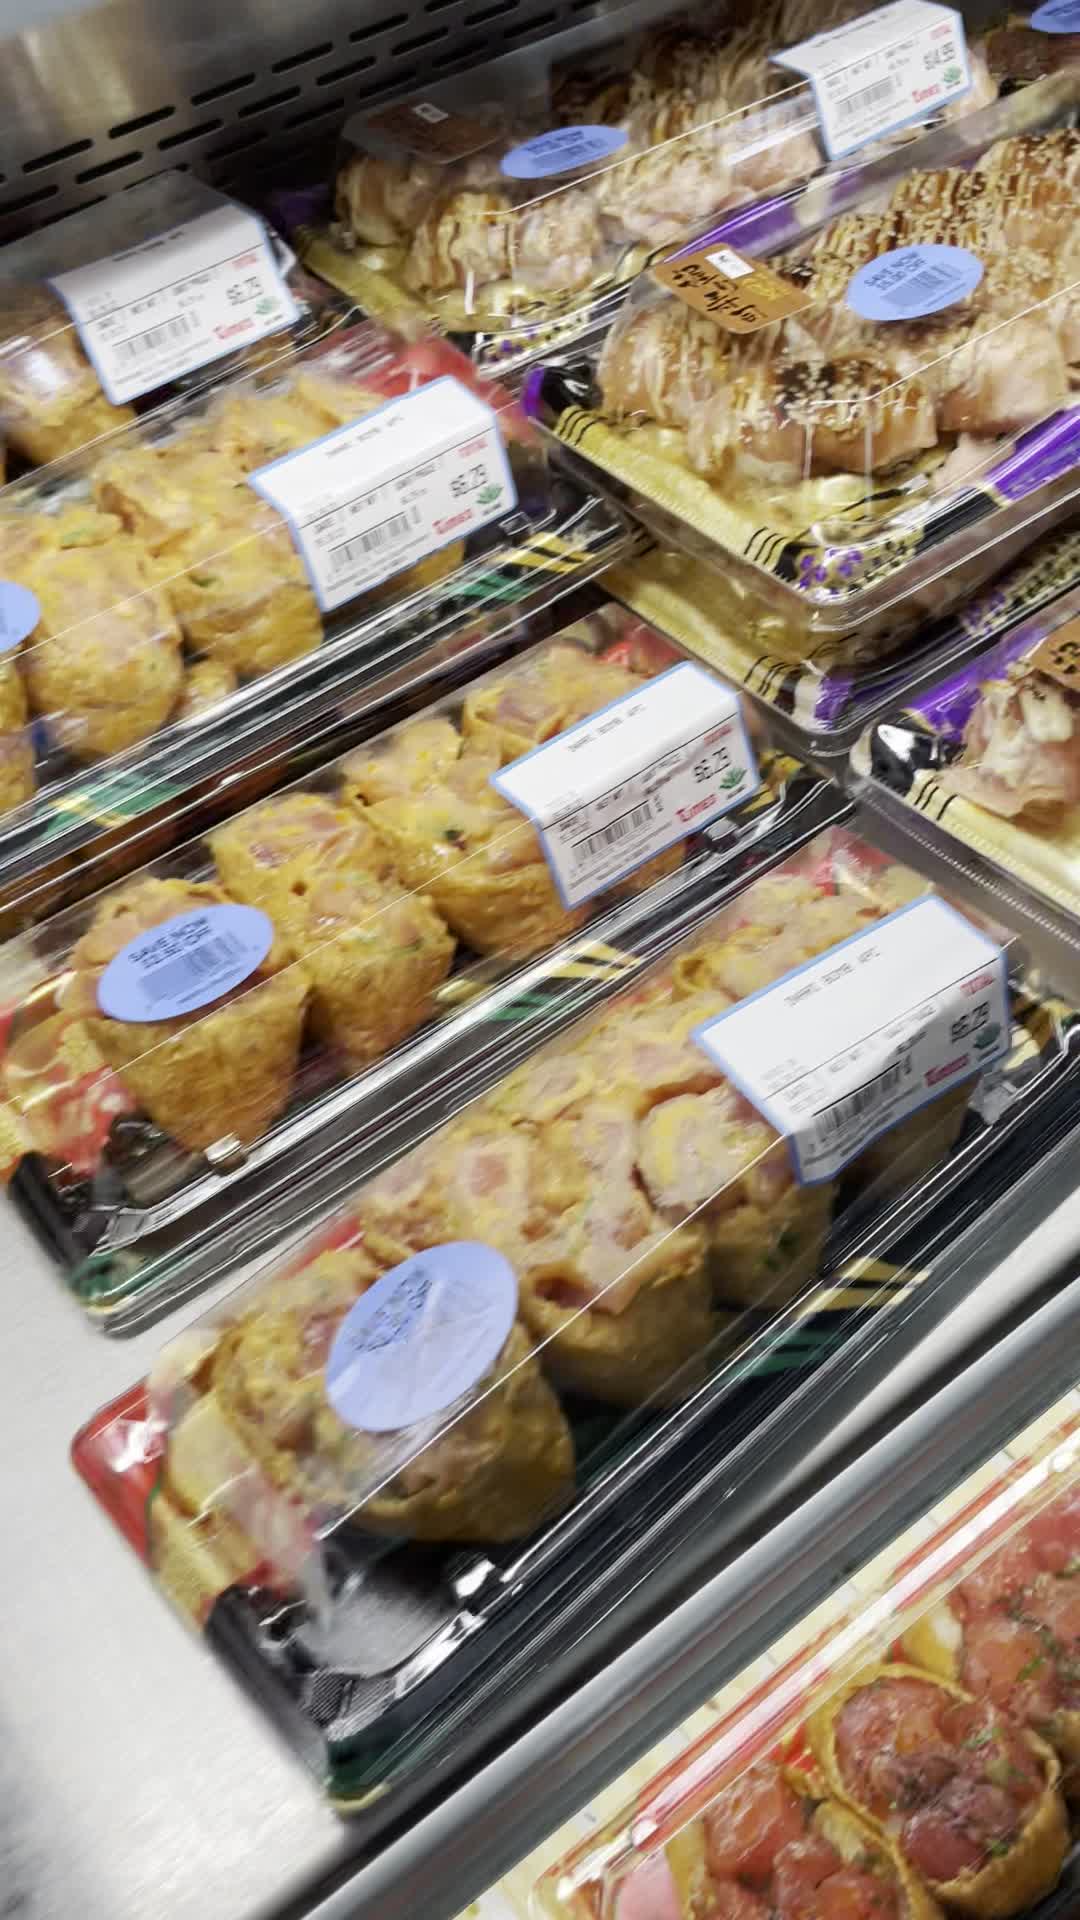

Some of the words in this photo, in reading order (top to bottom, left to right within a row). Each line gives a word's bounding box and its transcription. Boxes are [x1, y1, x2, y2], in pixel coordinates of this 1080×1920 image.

[890, 252, 918, 268] NOW
[676, 794, 719, 823] Times
[128, 936, 169, 964] SAVE
[170, 916, 208, 938] NOW
